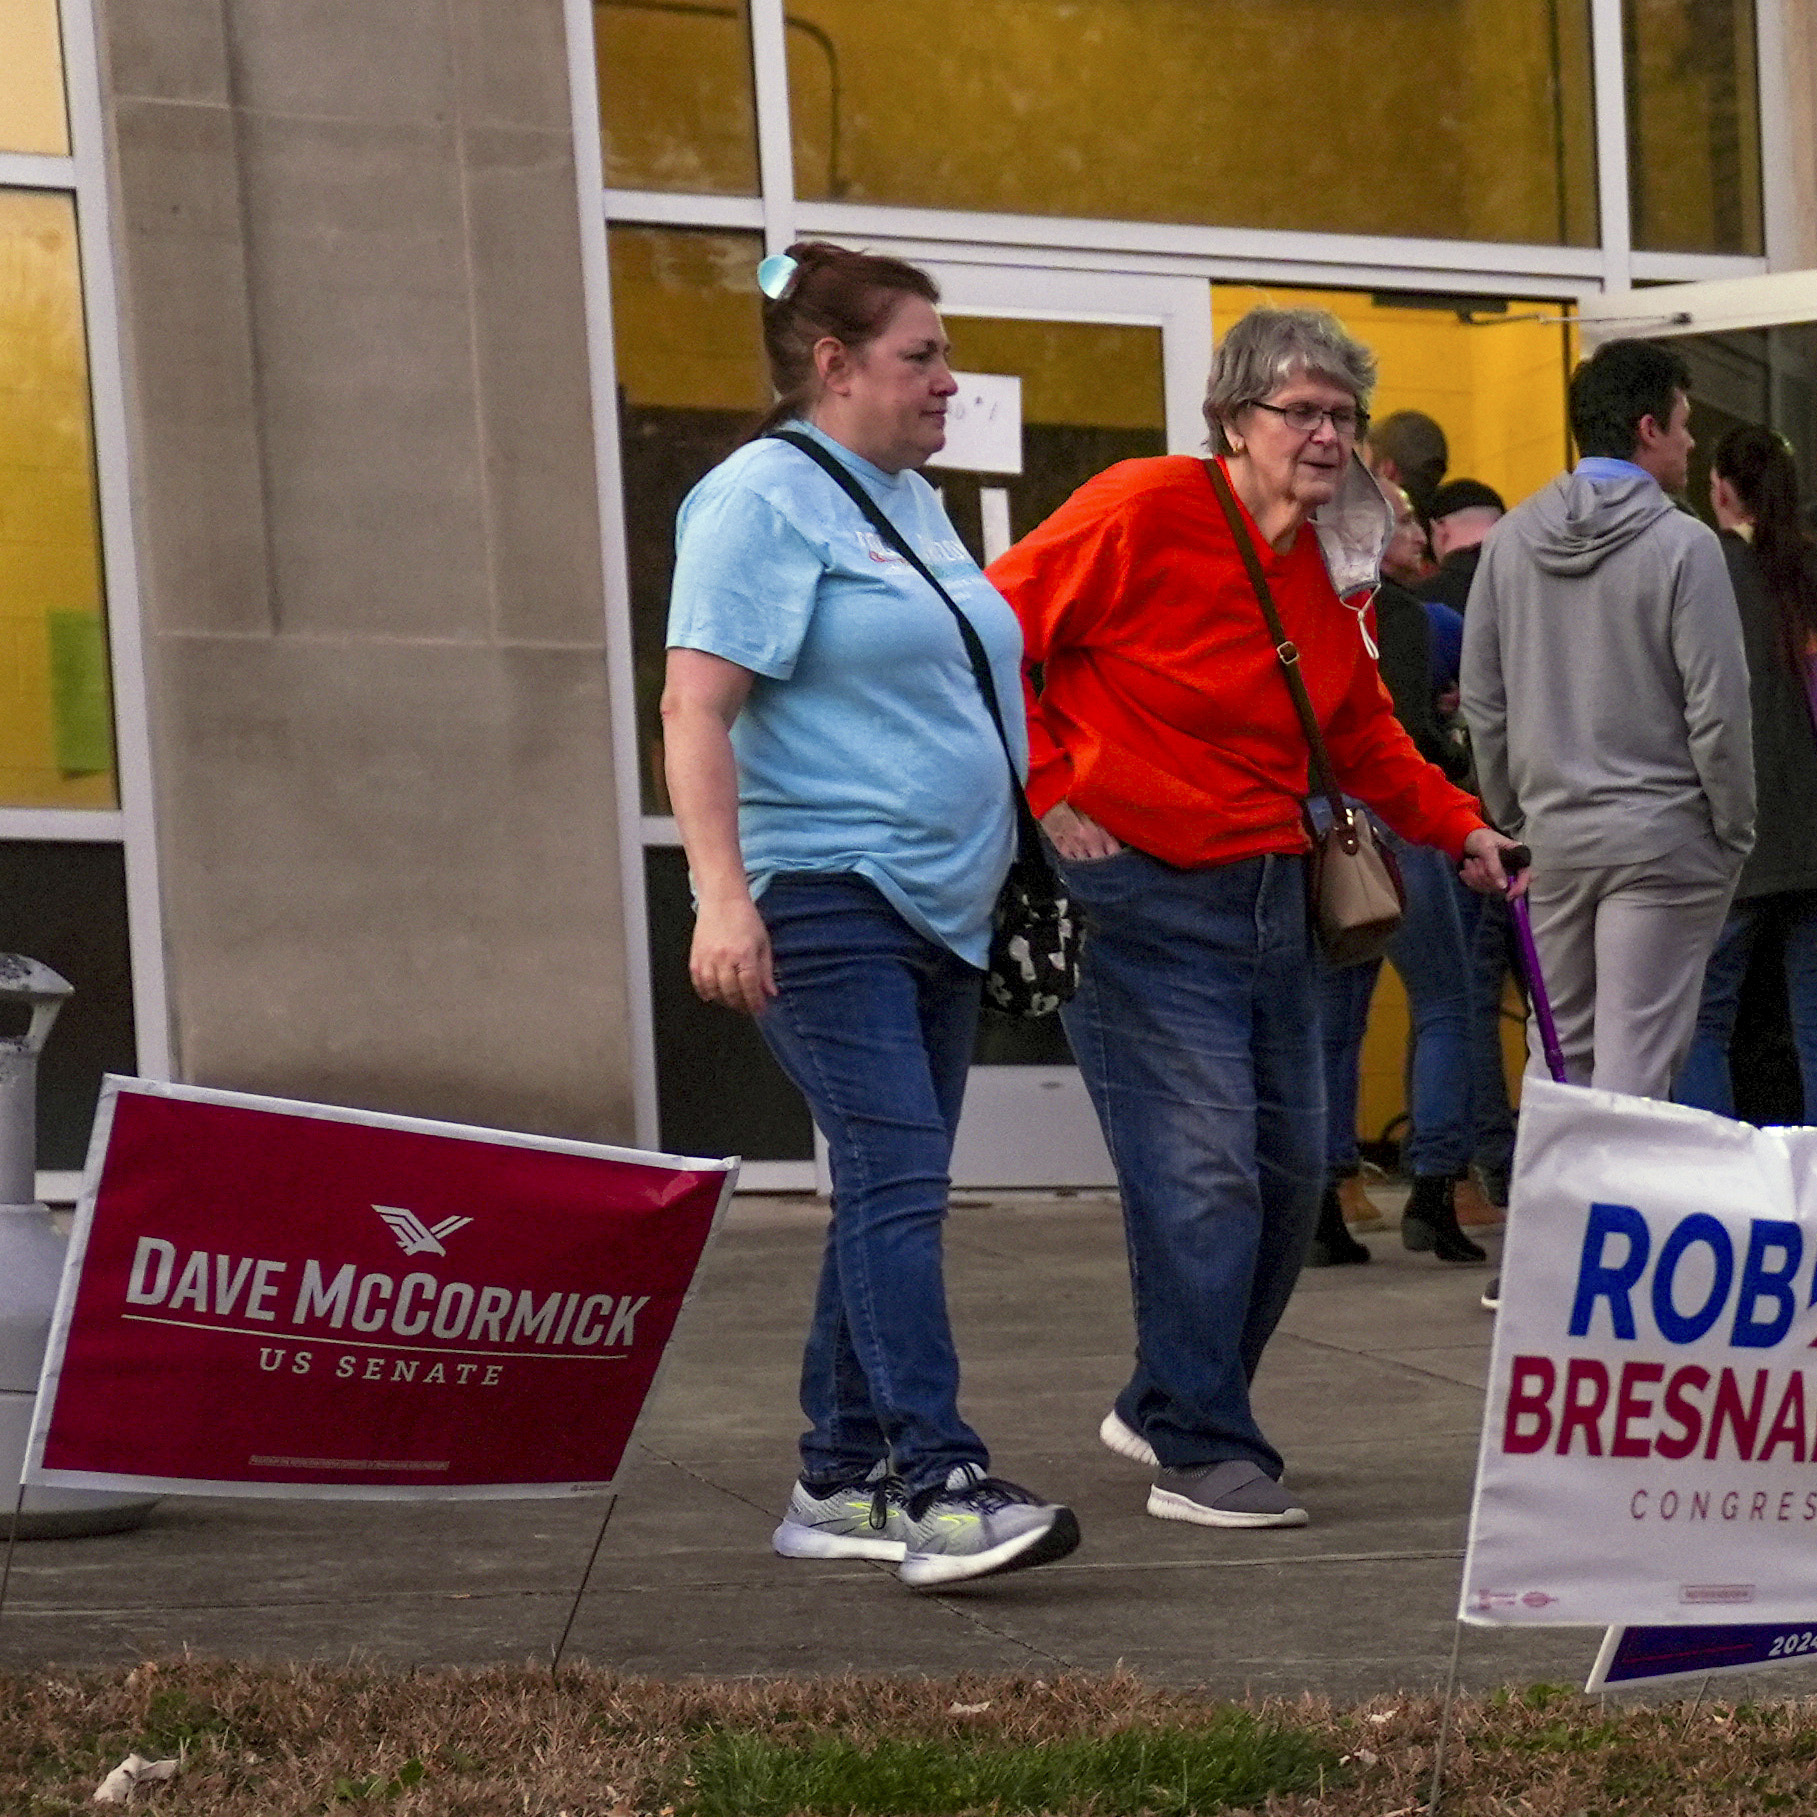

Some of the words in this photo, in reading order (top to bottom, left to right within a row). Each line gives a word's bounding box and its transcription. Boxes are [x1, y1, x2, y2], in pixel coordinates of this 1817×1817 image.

[126, 1236, 286, 1320] DAVE
[1567, 1202, 1802, 1348] ROB
[258, 1347, 311, 1375] US
[336, 1356, 504, 1386] SENATE
